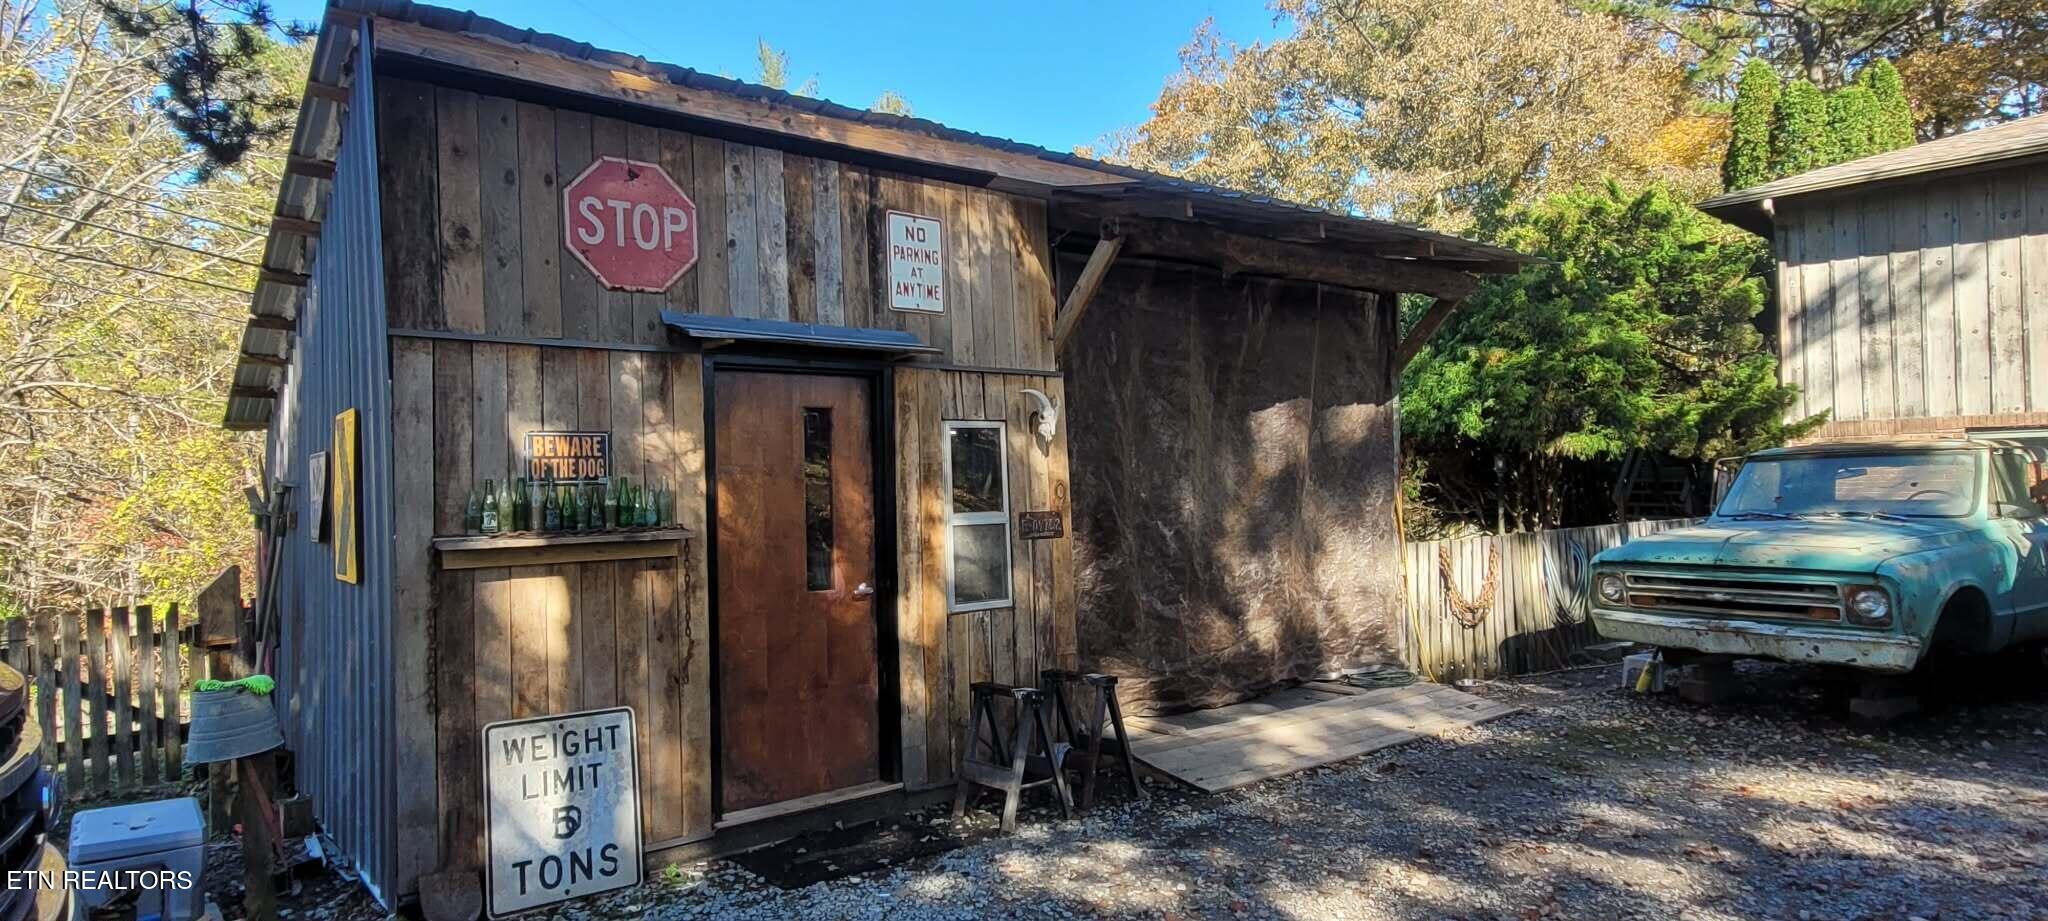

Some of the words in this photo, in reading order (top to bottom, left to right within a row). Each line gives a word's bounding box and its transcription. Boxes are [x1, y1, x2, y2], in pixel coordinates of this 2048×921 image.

[577, 196, 688, 252] STOP
[905, 225, 926, 242] NO
[893, 245, 939, 266] PARKING
[910, 266, 924, 279] AT
[895, 281, 940, 301] ANYTIME
[532, 435, 602, 457] BEWARE
[531, 458, 549, 478] OF
[550, 458, 577, 478] THE
[579, 458, 605, 478] DOG
[502, 725, 620, 766] WEIGHT
[521, 762, 602, 801] LIMIT
[511, 843, 620, 896] TONS
